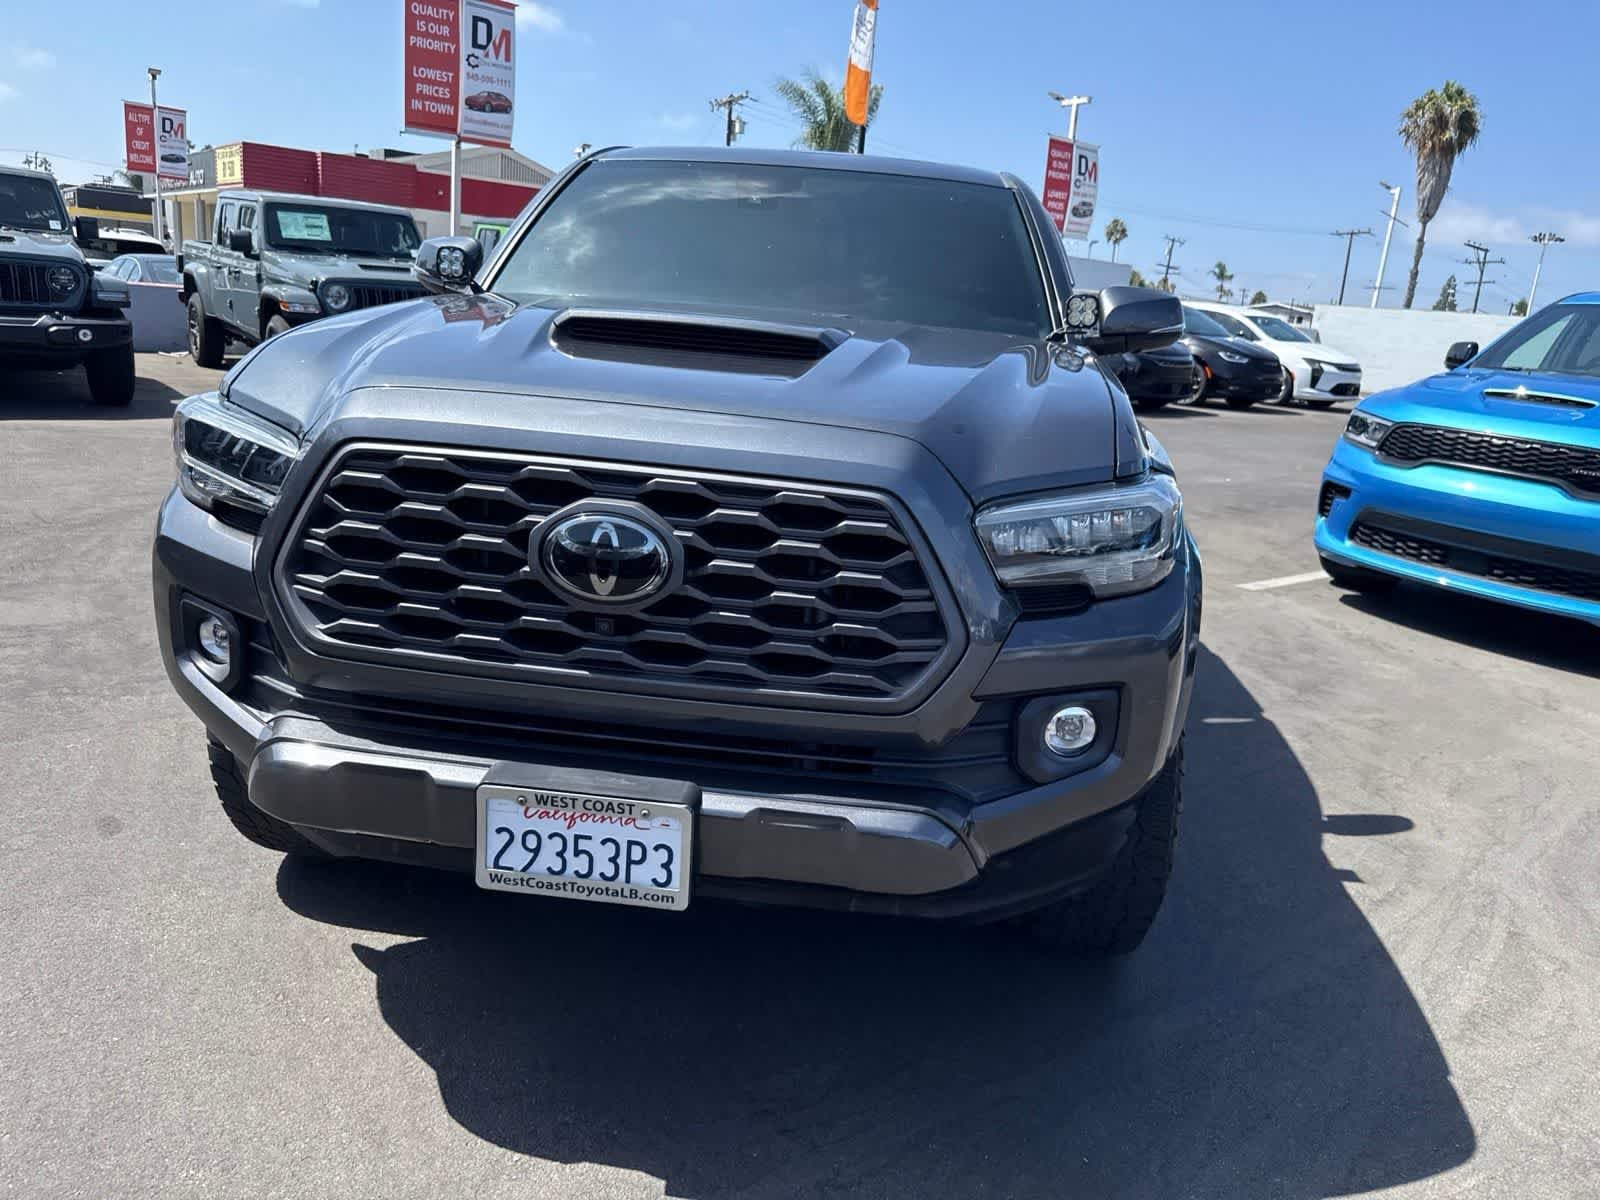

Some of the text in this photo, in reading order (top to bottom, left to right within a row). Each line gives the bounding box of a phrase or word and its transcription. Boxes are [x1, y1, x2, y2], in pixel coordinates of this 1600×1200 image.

[411, 2, 455, 20] QUALITY
[416, 20, 450, 37] IS OUR
[409, 36, 456, 54] PRIORITY
[412, 66, 454, 83] LOWEST
[416, 83, 451, 99] PRICES
[411, 99, 455, 115] IN TOWN
[128, 112, 151, 125] ALL TYPE
[136, 127, 144, 136] OF
[132, 140, 150, 150] CREDIT
[129, 153, 154, 165] WELCOME
[1050, 150, 1072, 159] QUALITY
[189, 168, 205, 186] AUTO
[1047, 171, 1071, 181] PRIORITY
[1047, 190, 1068, 200] LOWEST
[534, 793, 635, 816] WEST COAST
[492, 826, 674, 889] 29353P3
[488, 873, 676, 905] WestCoastToyotaLB.com
